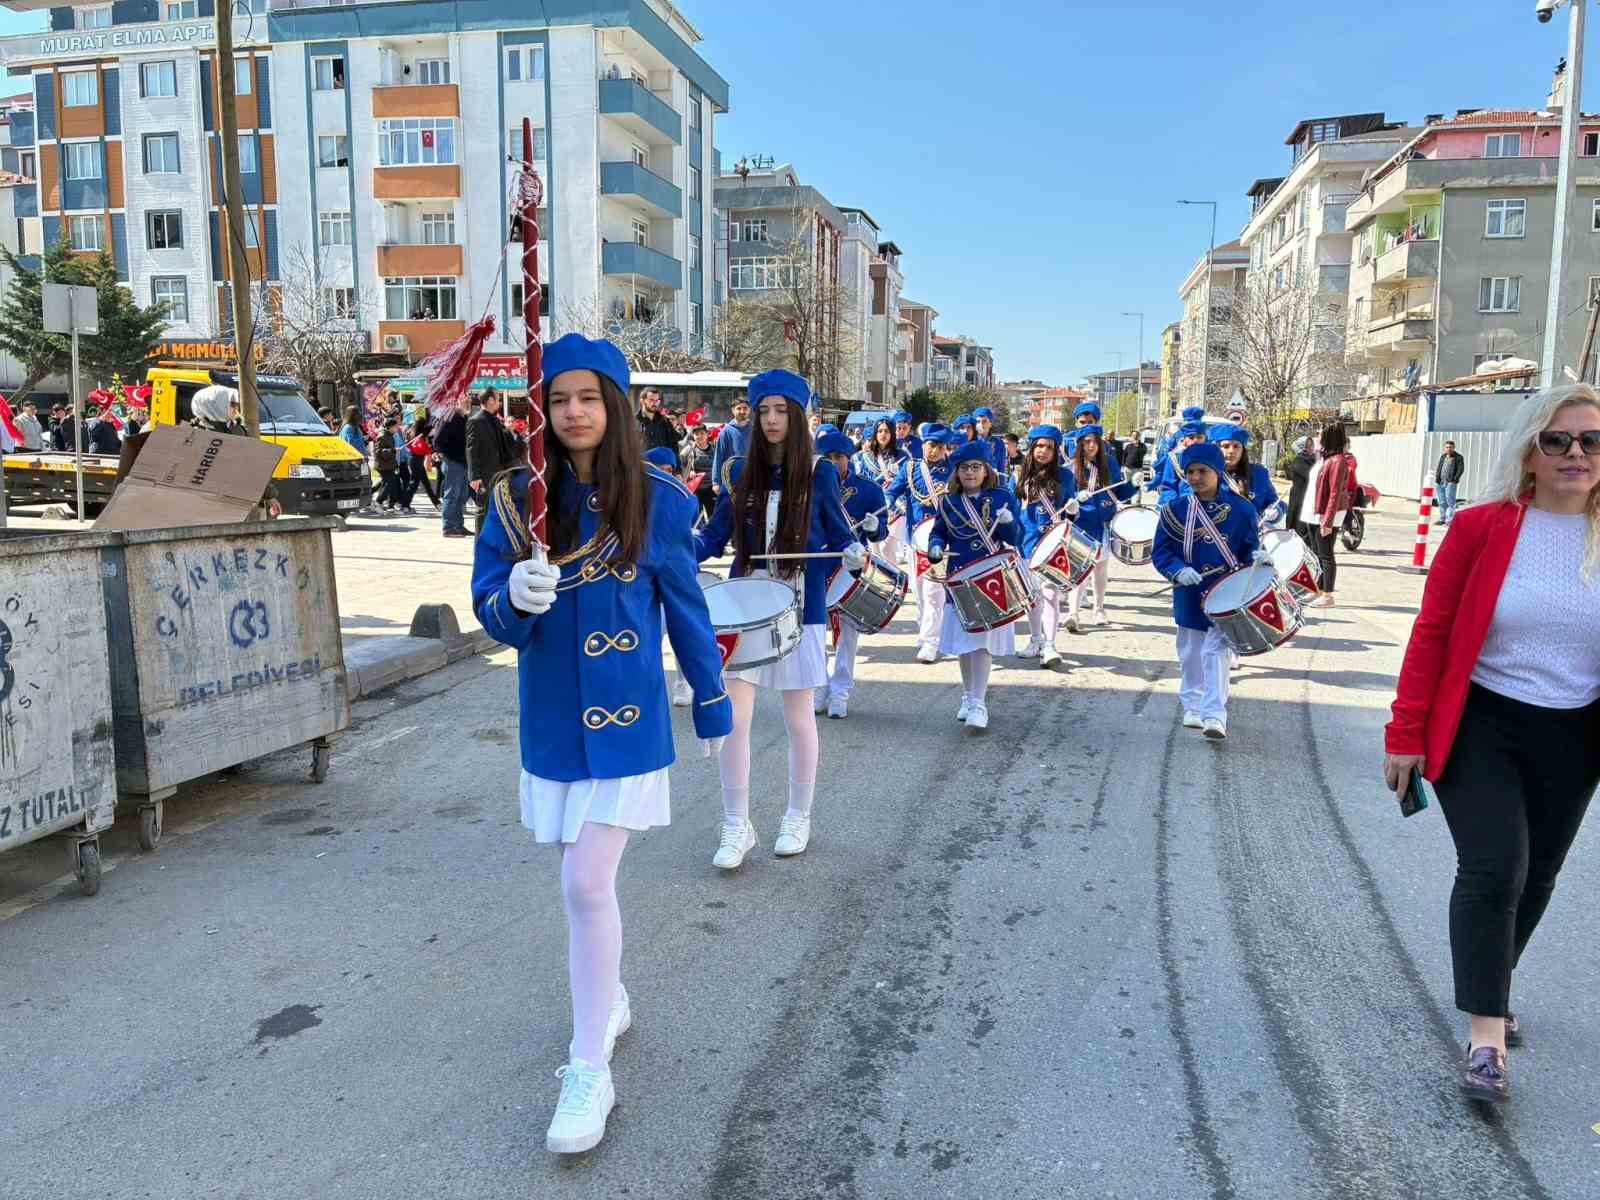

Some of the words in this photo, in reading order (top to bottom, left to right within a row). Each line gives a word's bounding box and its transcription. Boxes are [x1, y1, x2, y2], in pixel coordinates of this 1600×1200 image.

[40, 36, 107, 54] MURAT
[112, 29, 166, 47] ELMA
[172, 23, 215, 42] APT.
[480, 368, 528, 377] MAR
[192, 438, 223, 485] HARIBO
